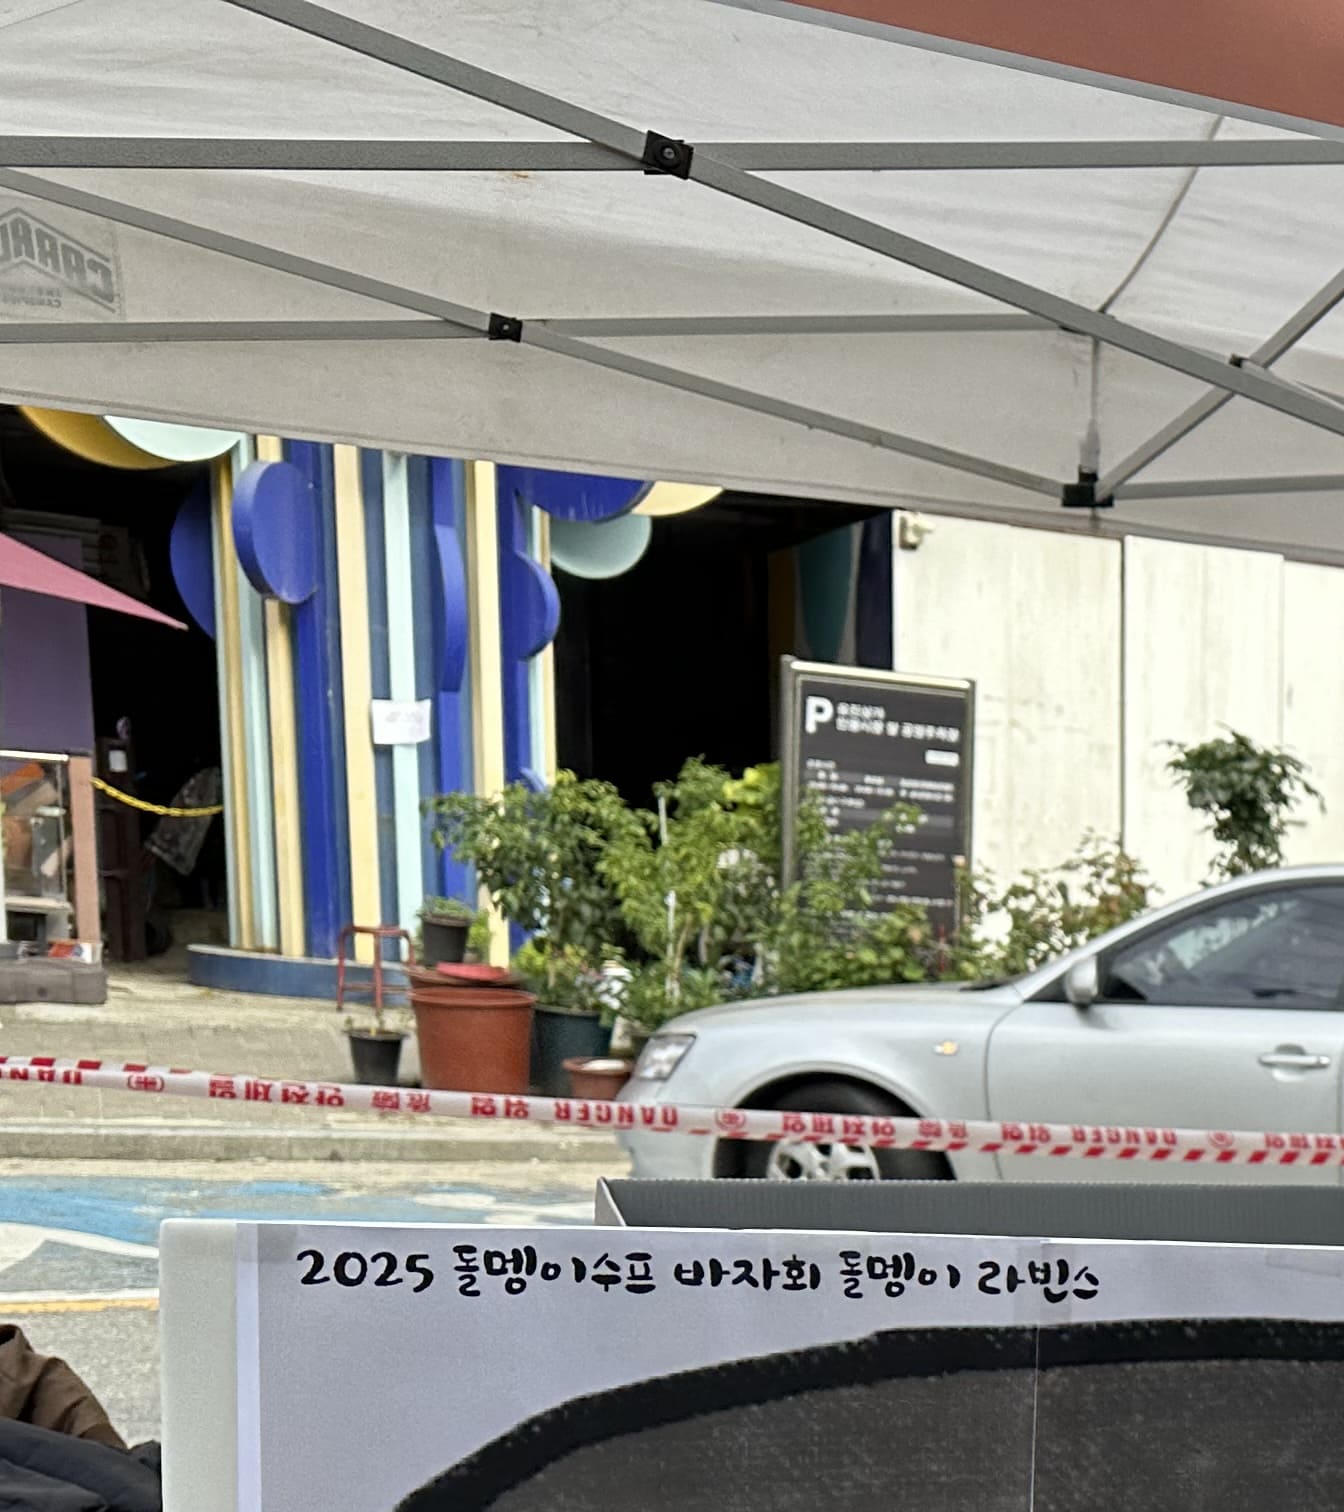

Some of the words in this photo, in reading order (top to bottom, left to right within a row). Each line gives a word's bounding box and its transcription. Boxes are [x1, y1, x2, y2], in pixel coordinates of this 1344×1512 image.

[805, 696, 834, 734] P
[297, 1249, 434, 1293] 2025
[452, 1244, 657, 1297] 돌멩이수프
[673, 1253, 821, 1292] 바자회
[838, 1250, 958, 1299] 돌멩이
[977, 1258, 1100, 1304] 라빈스
